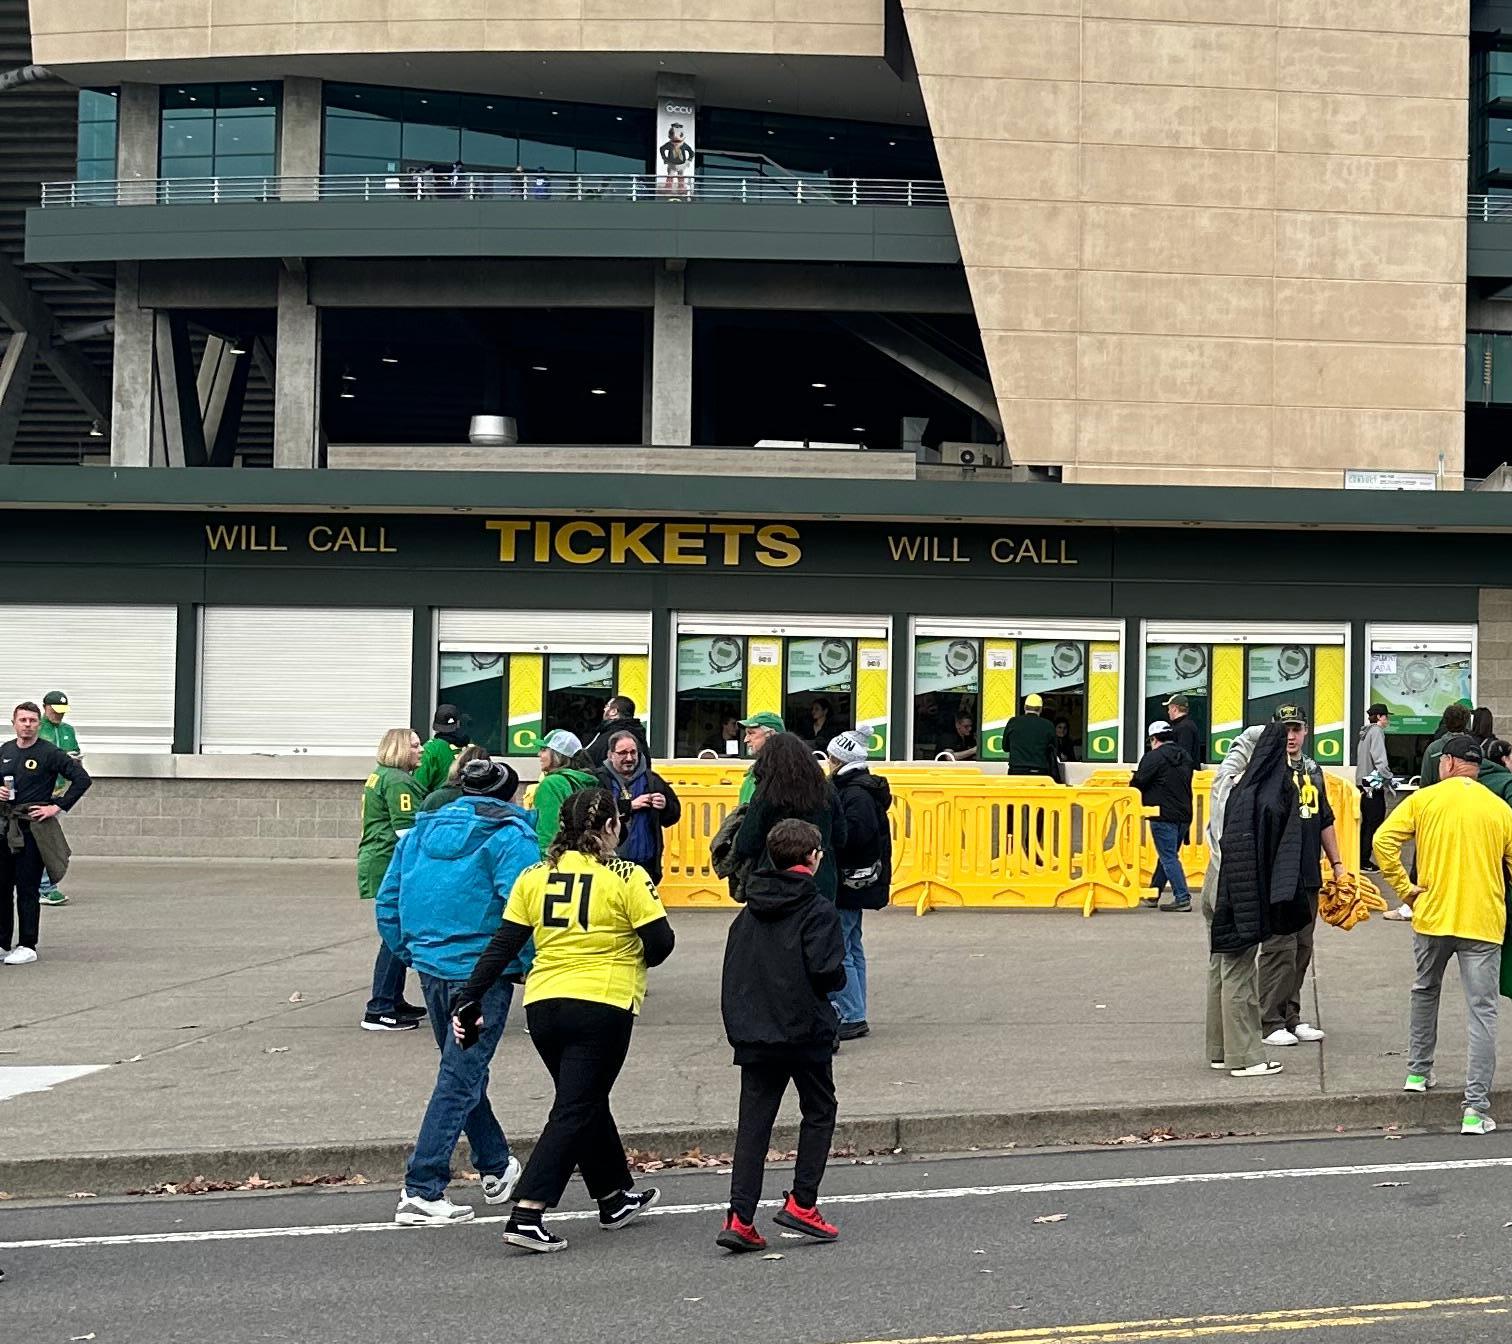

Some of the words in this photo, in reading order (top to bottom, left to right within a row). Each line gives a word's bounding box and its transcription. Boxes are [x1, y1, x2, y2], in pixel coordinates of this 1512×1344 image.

[205, 525, 288, 551] WILL
[308, 526, 398, 552] CALL
[485, 520, 802, 567] TICKETS
[888, 536, 970, 562] WILL
[991, 538, 1078, 564] CALL
[400, 793, 412, 812] 8
[543, 872, 593, 932] 21
